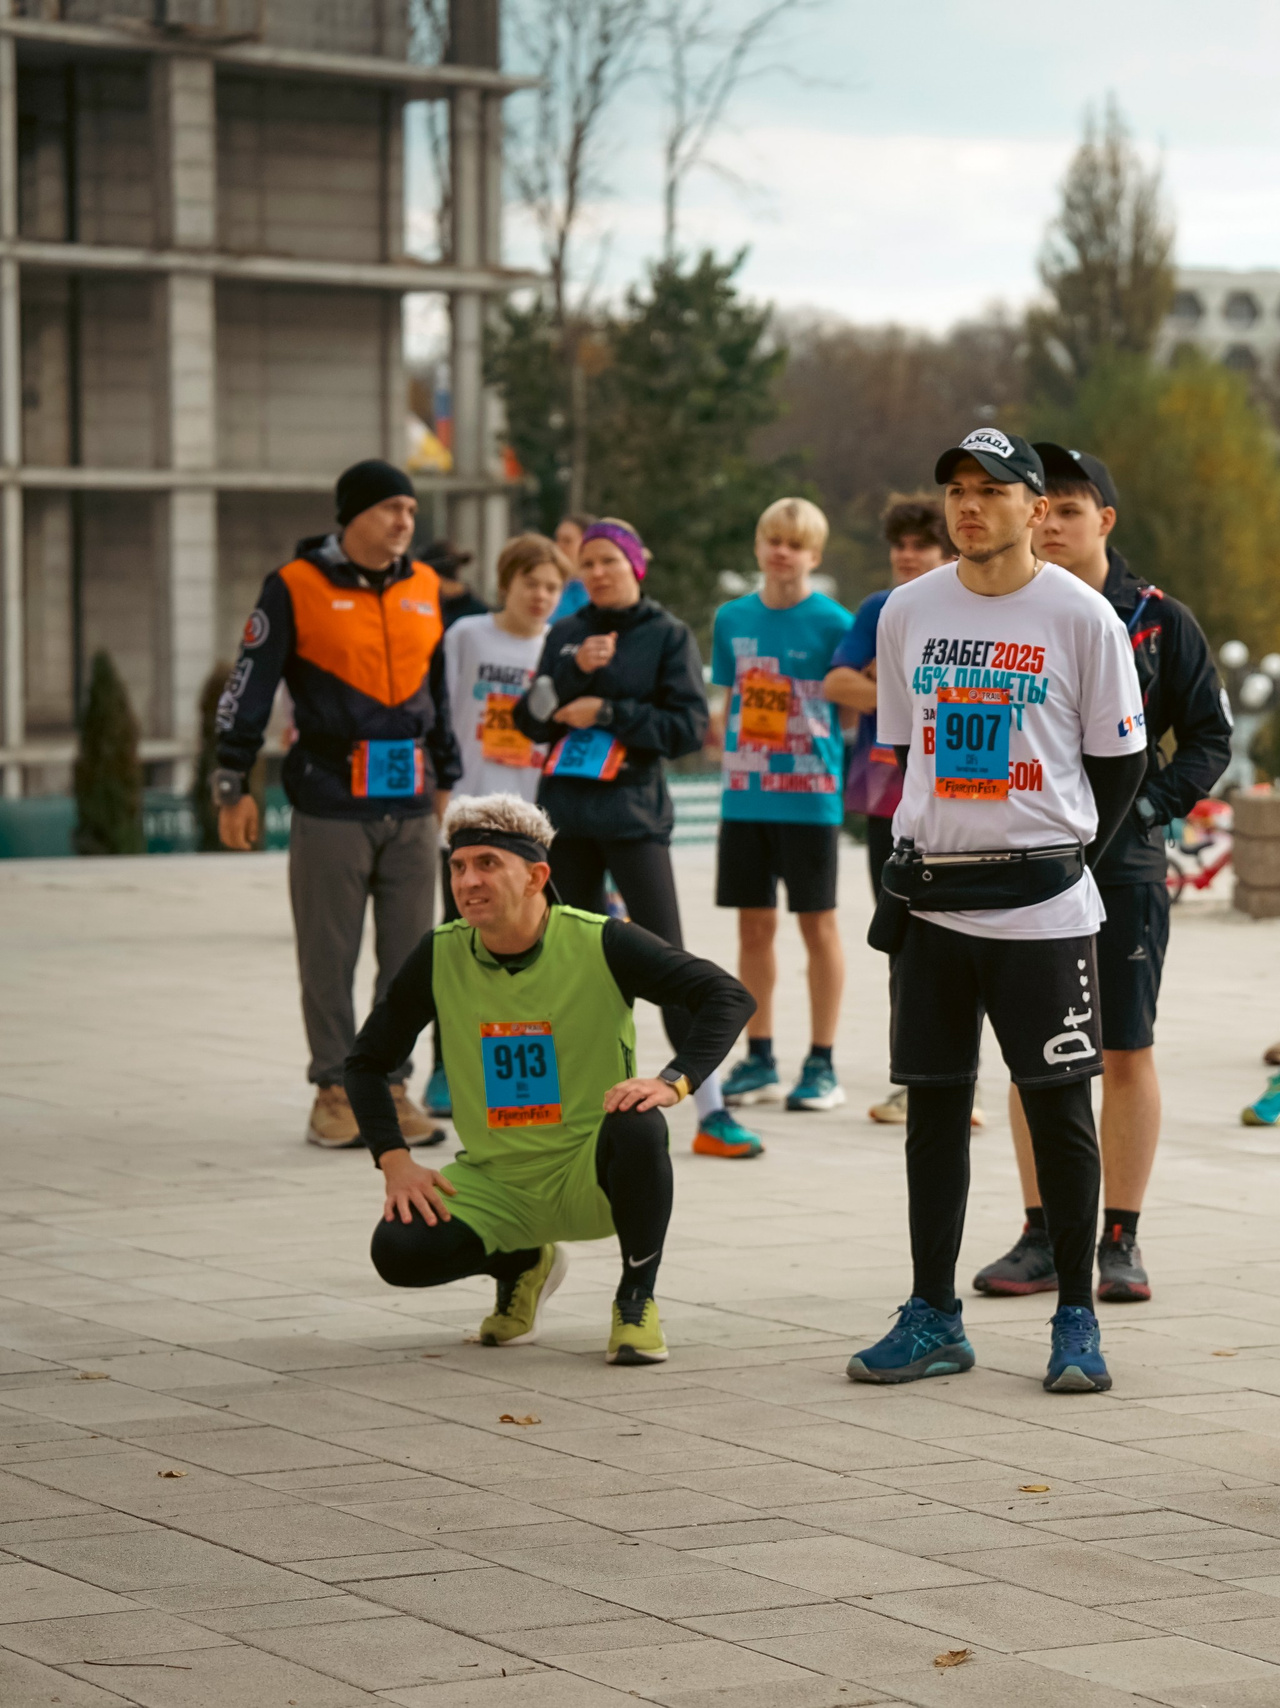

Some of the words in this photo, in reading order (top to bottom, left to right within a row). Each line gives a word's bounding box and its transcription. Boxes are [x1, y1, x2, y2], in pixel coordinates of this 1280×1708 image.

[922, 638, 1046, 674] #ЗАБЕГ2025
[946, 713, 1002, 751] 907
[493, 1042, 547, 1080] 913
